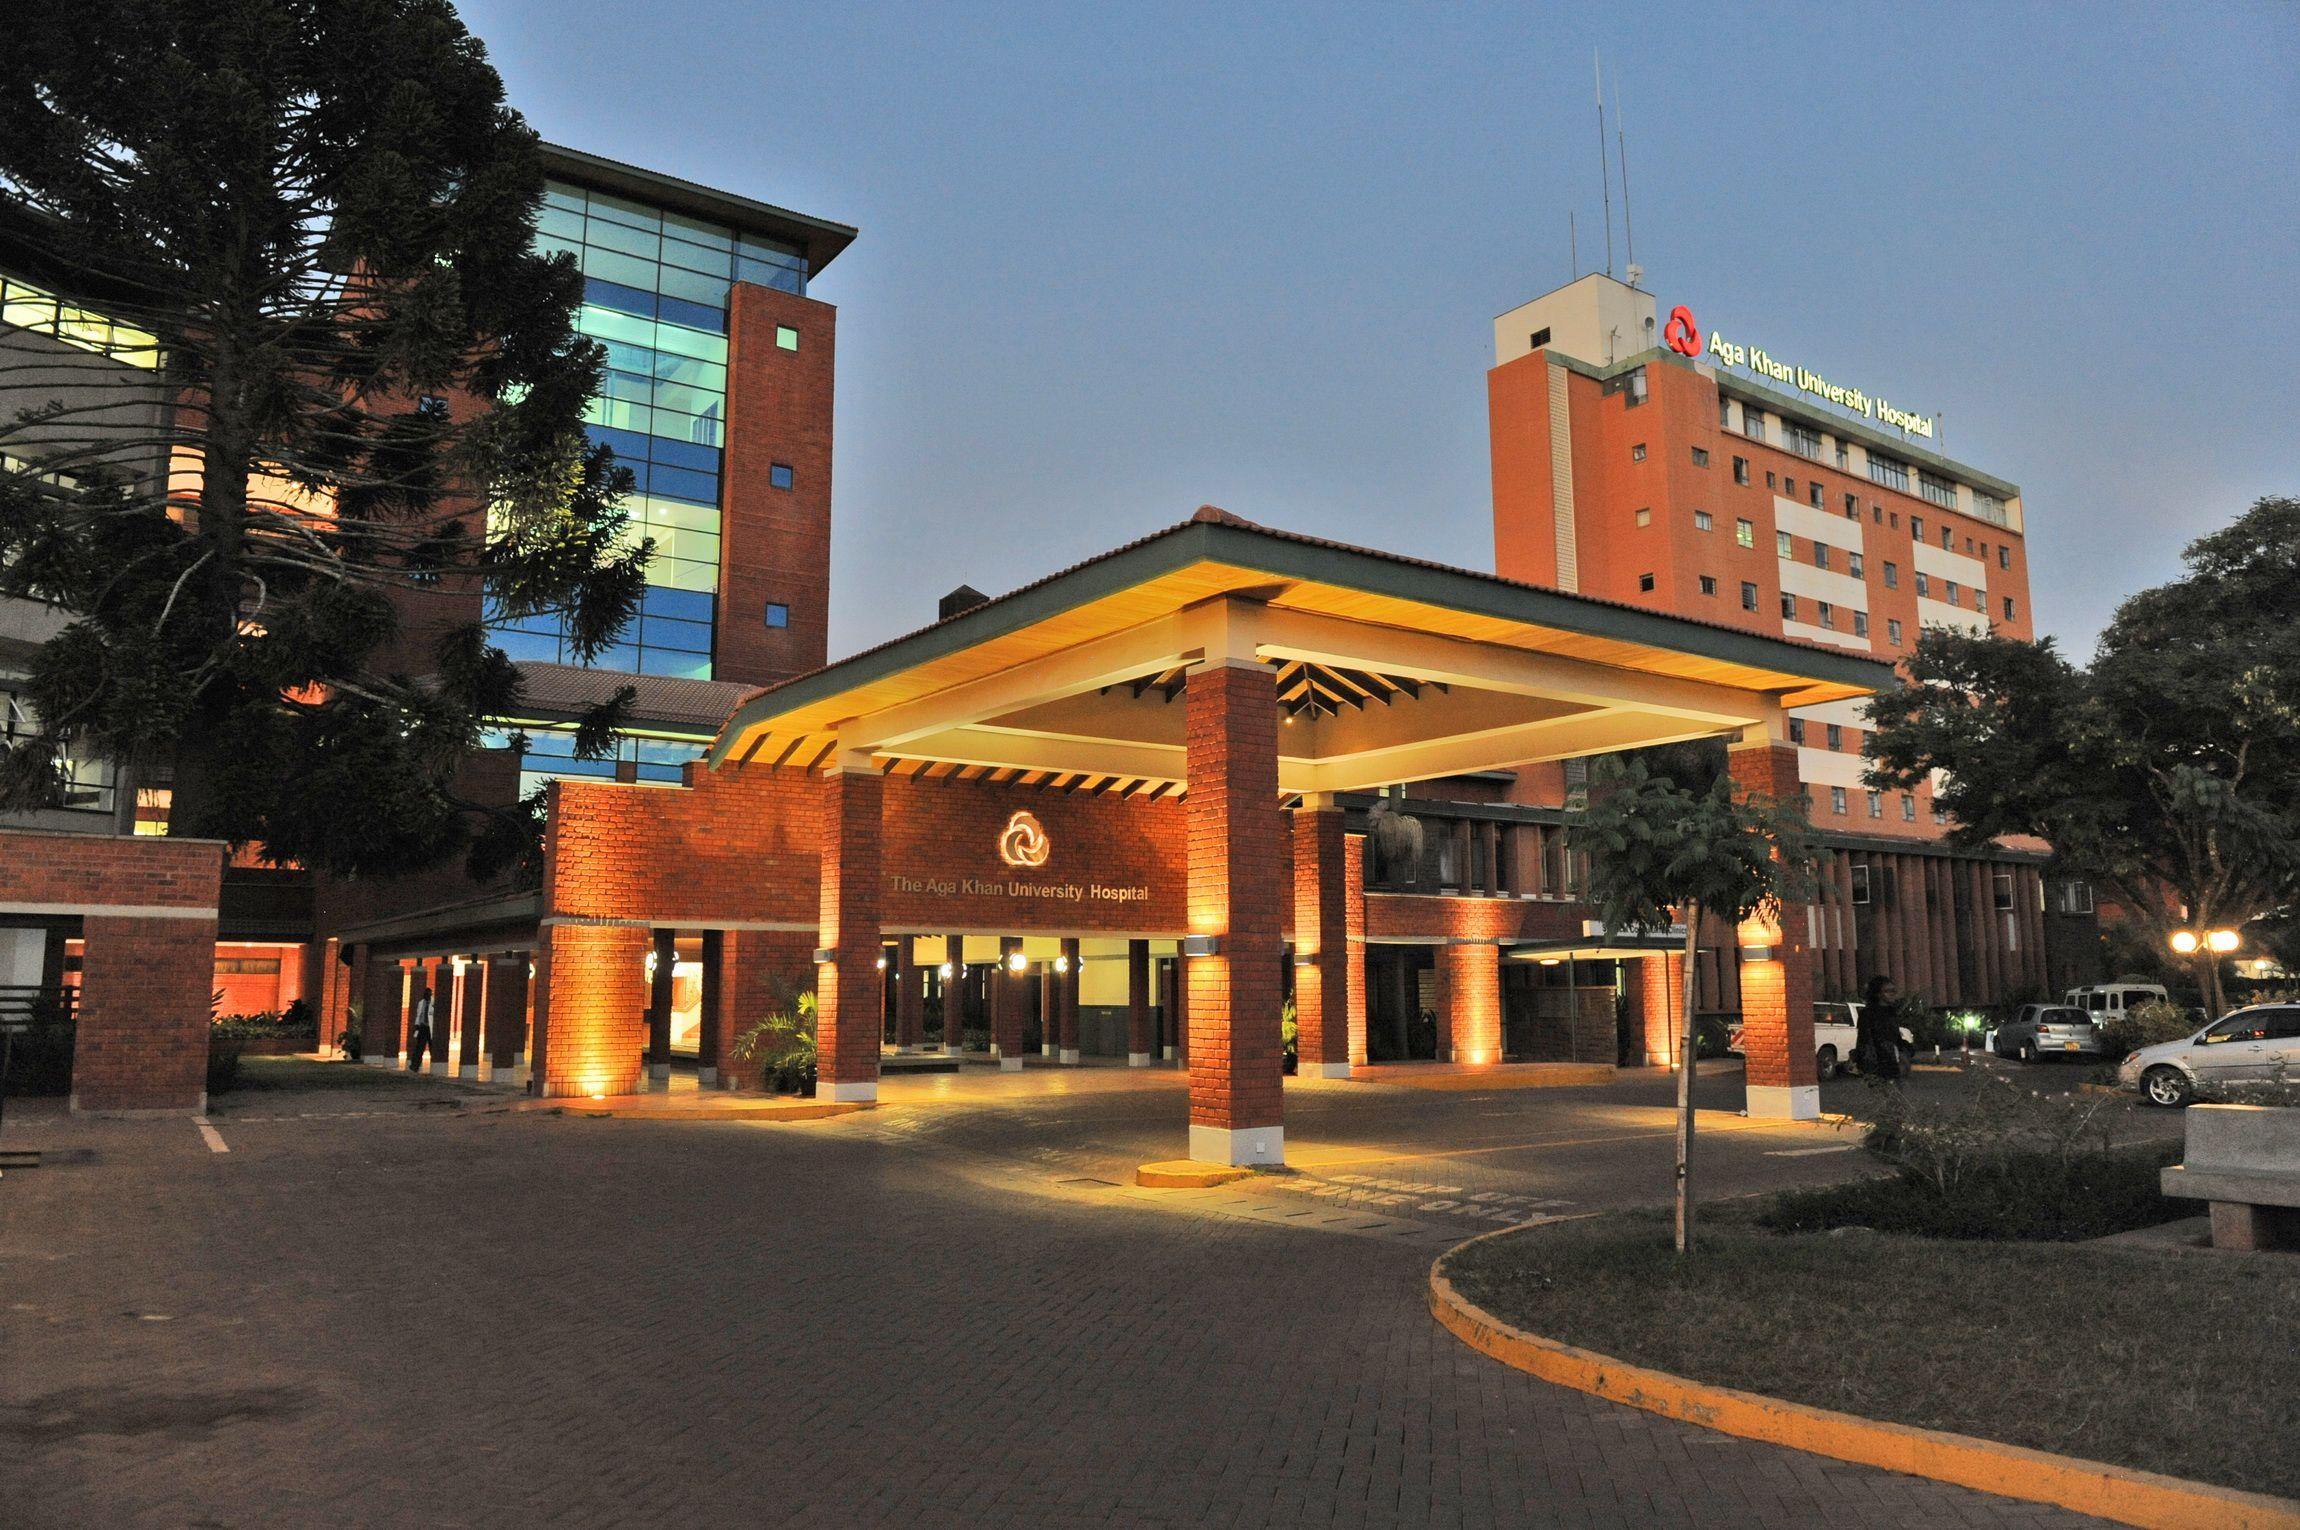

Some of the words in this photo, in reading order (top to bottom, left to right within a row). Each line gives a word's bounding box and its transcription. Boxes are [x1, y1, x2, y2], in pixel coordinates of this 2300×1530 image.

[1709, 331, 1745, 366] Aga
[1749, 345, 1793, 384] Khan
[1796, 366, 1872, 418] University
[1876, 398, 1932, 438] Hospital
[890, 876, 922, 892] The
[926, 878, 957, 897] Aga
[962, 879, 1003, 896] Khan
[1009, 881, 1083, 902] University
[1090, 884, 1149, 903] Hospital
[1418, 1200, 1568, 1224] ONLY
